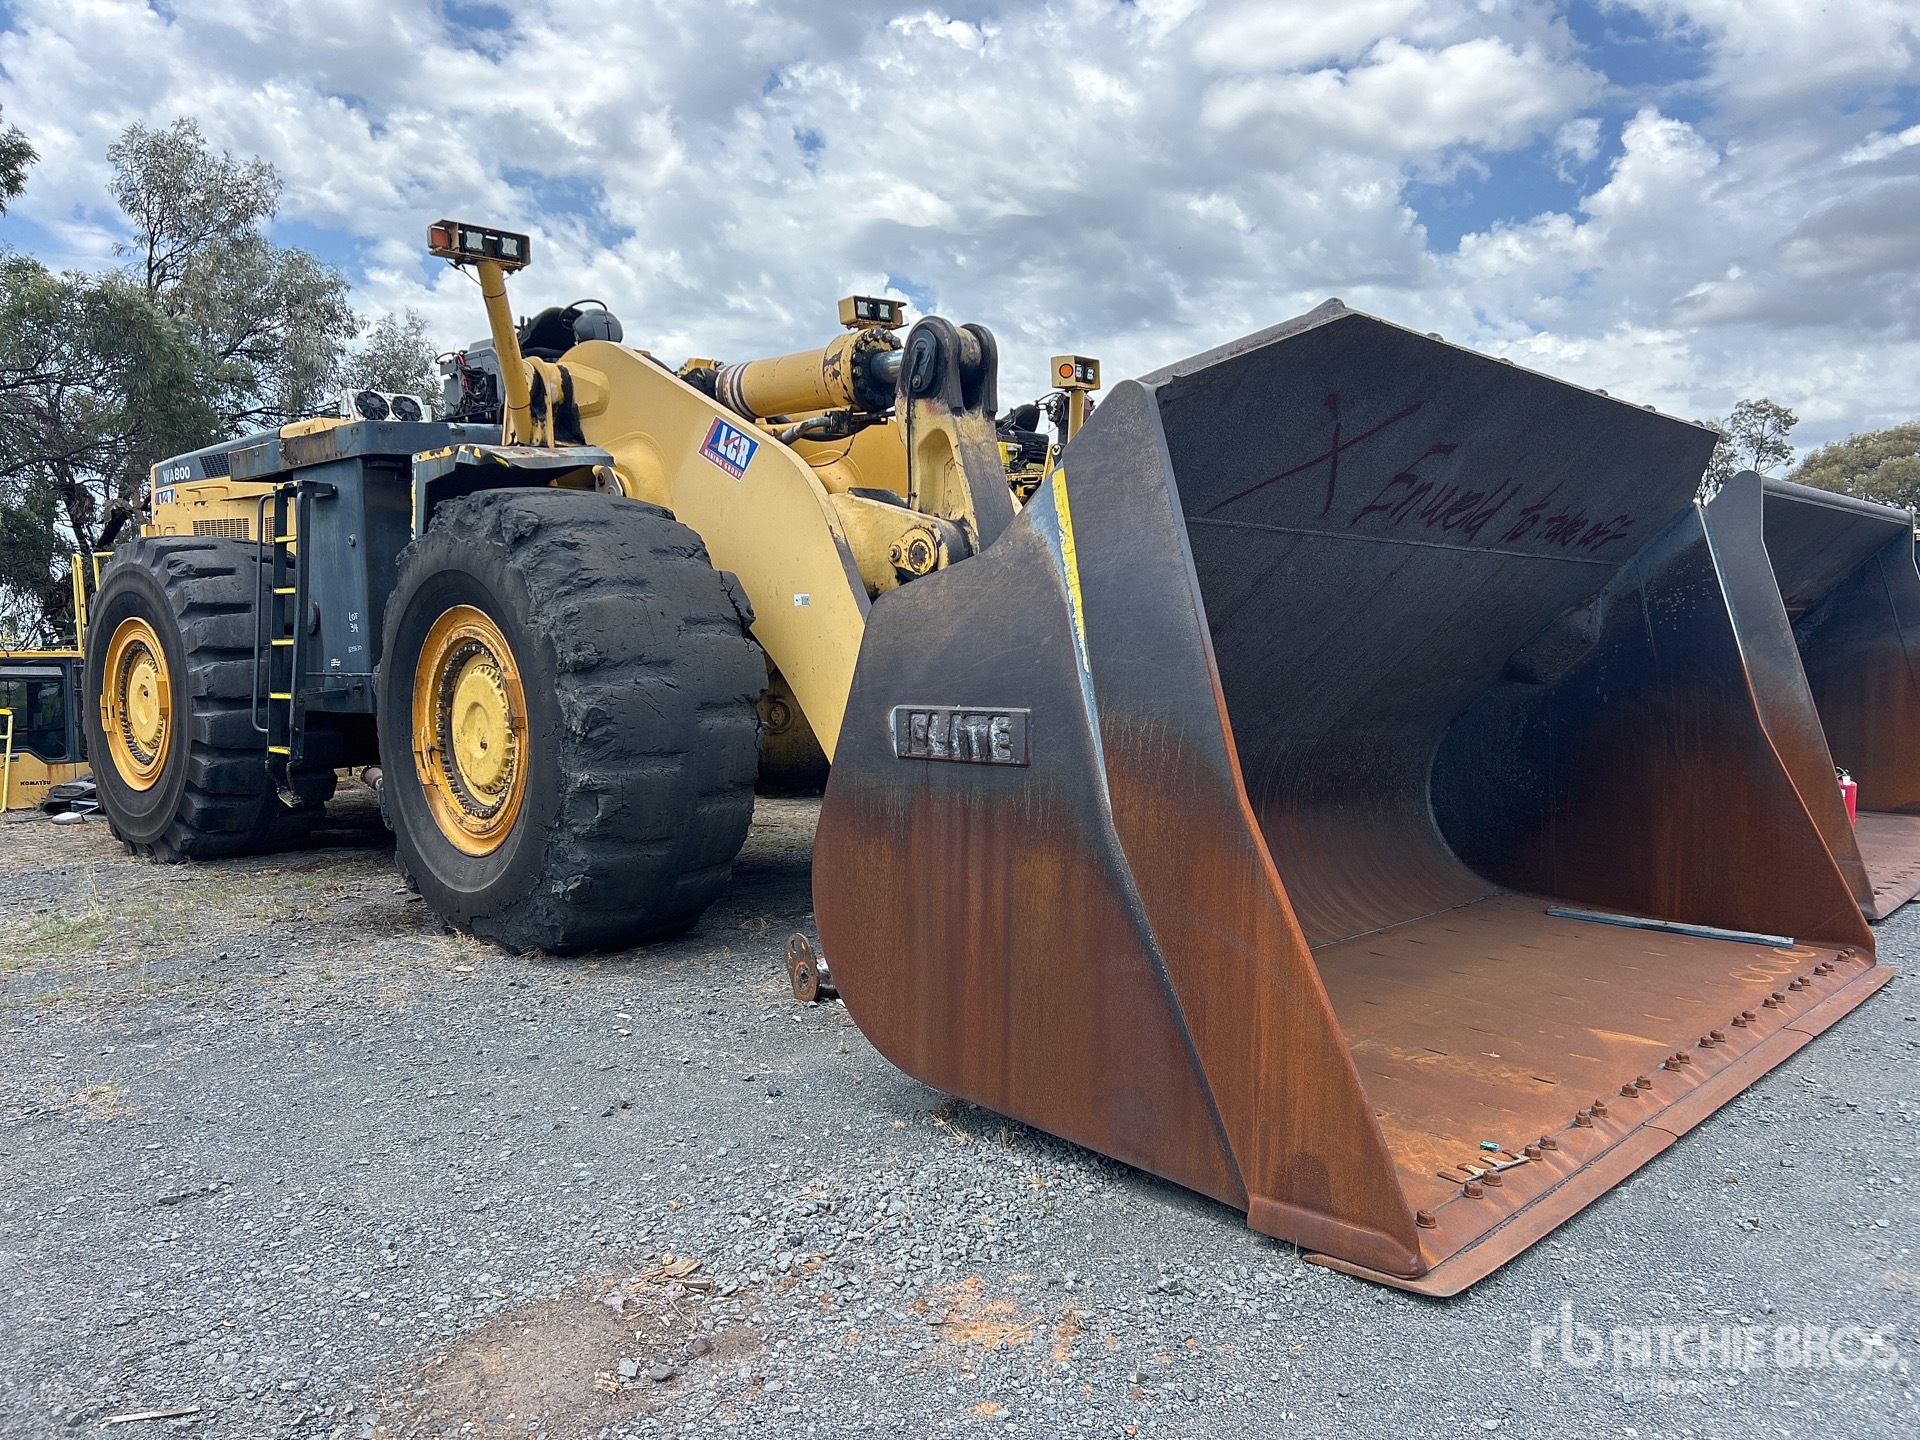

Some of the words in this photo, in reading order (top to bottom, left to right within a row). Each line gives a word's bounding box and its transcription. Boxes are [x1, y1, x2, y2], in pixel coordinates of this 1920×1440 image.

[163, 466, 190, 483] WA800
[704, 449, 723, 466] MINING
[724, 462, 741, 478] GROUP
